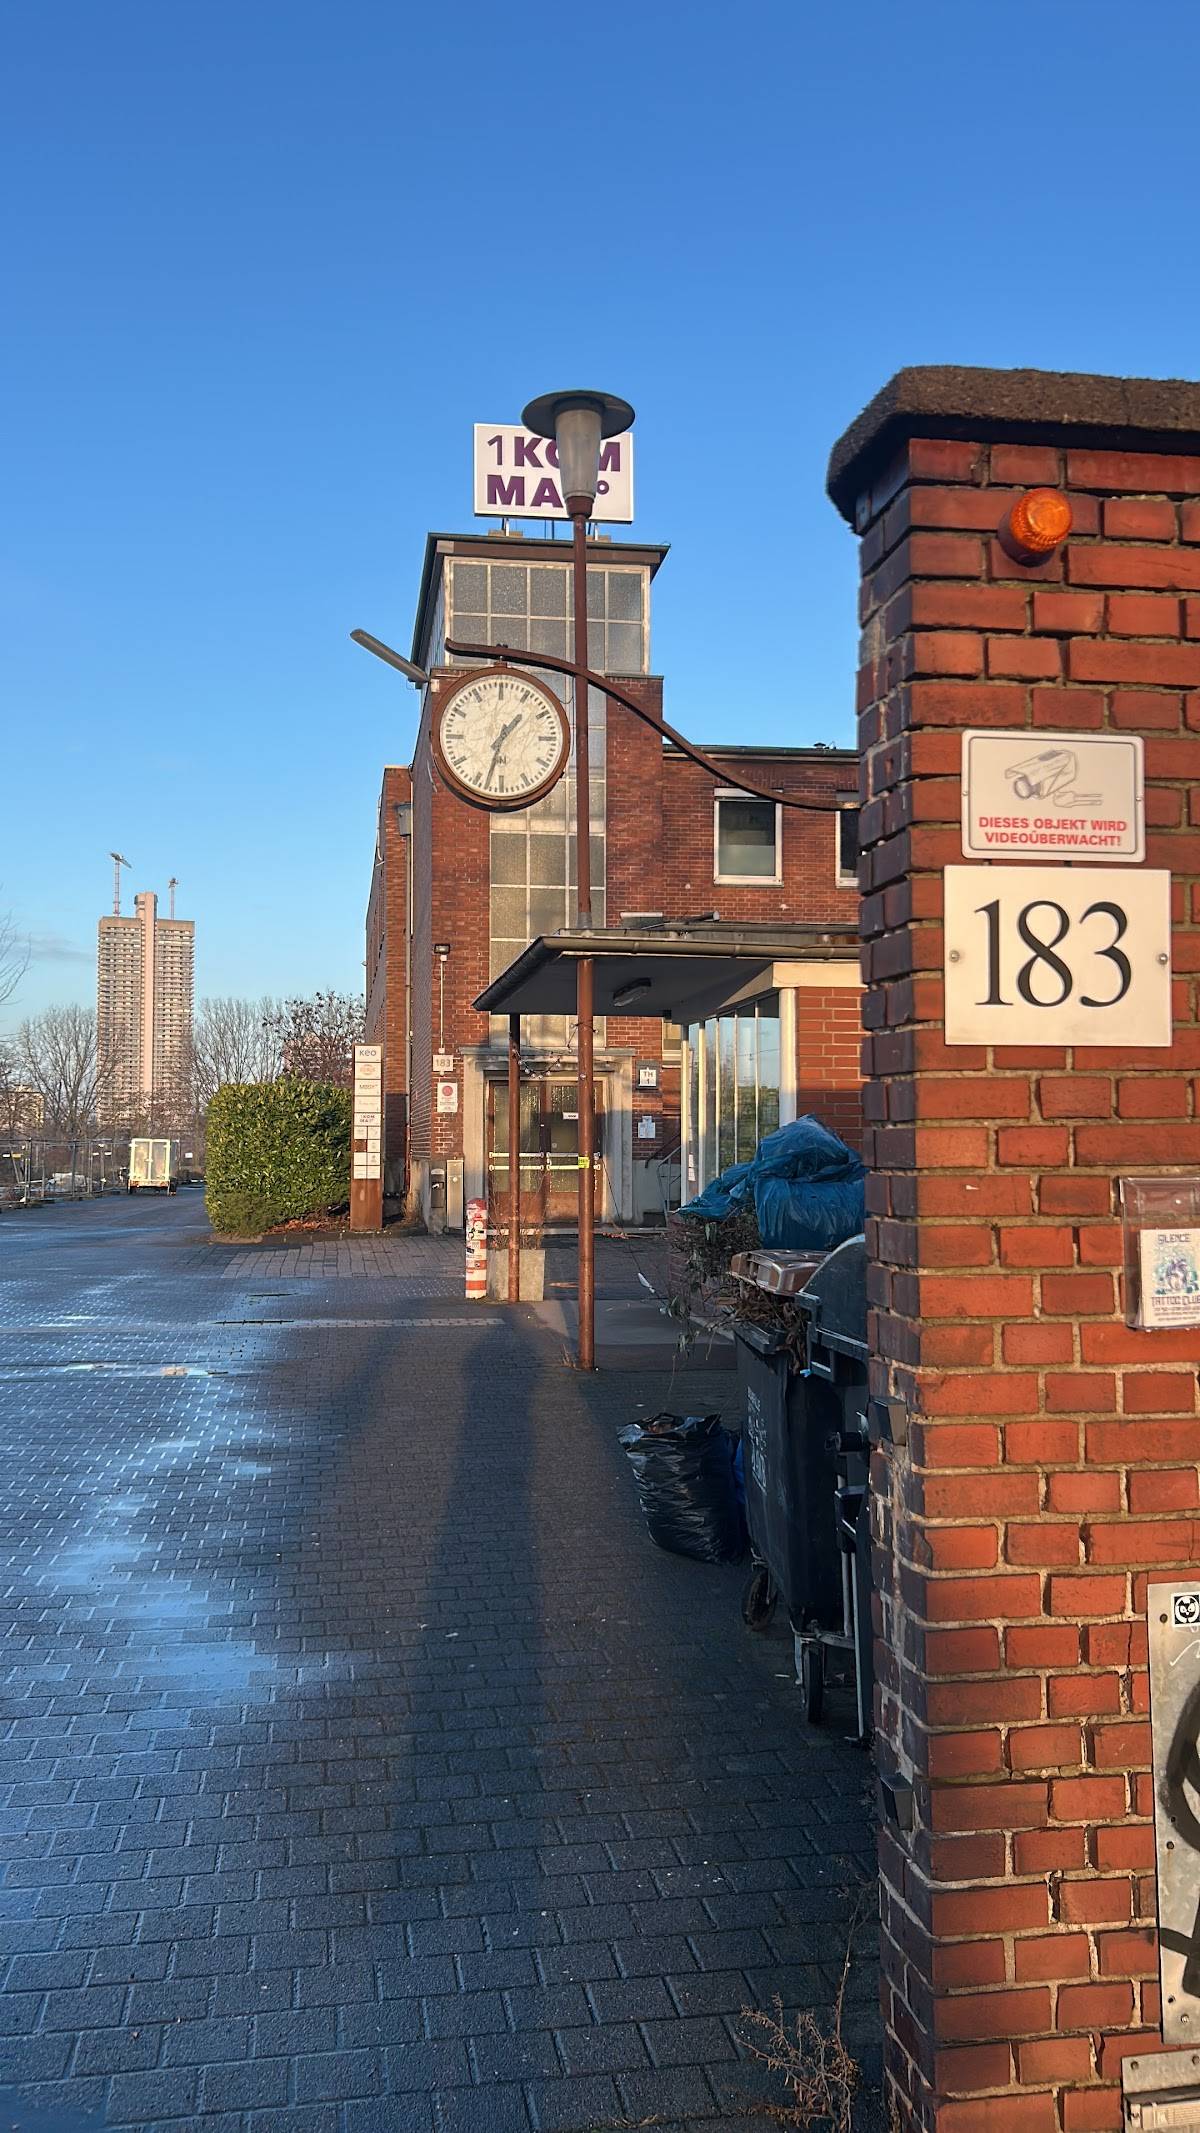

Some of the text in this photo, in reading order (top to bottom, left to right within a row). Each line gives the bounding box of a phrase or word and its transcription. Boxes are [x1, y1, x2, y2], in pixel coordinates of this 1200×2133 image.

[979, 817, 1127, 832] DIESES OBJEKT WIRD
[985, 831, 1121, 846] VIDEOÜBERWACHT!
[974, 899, 1132, 1008] 183
[436, 1059, 451, 1067] 183
